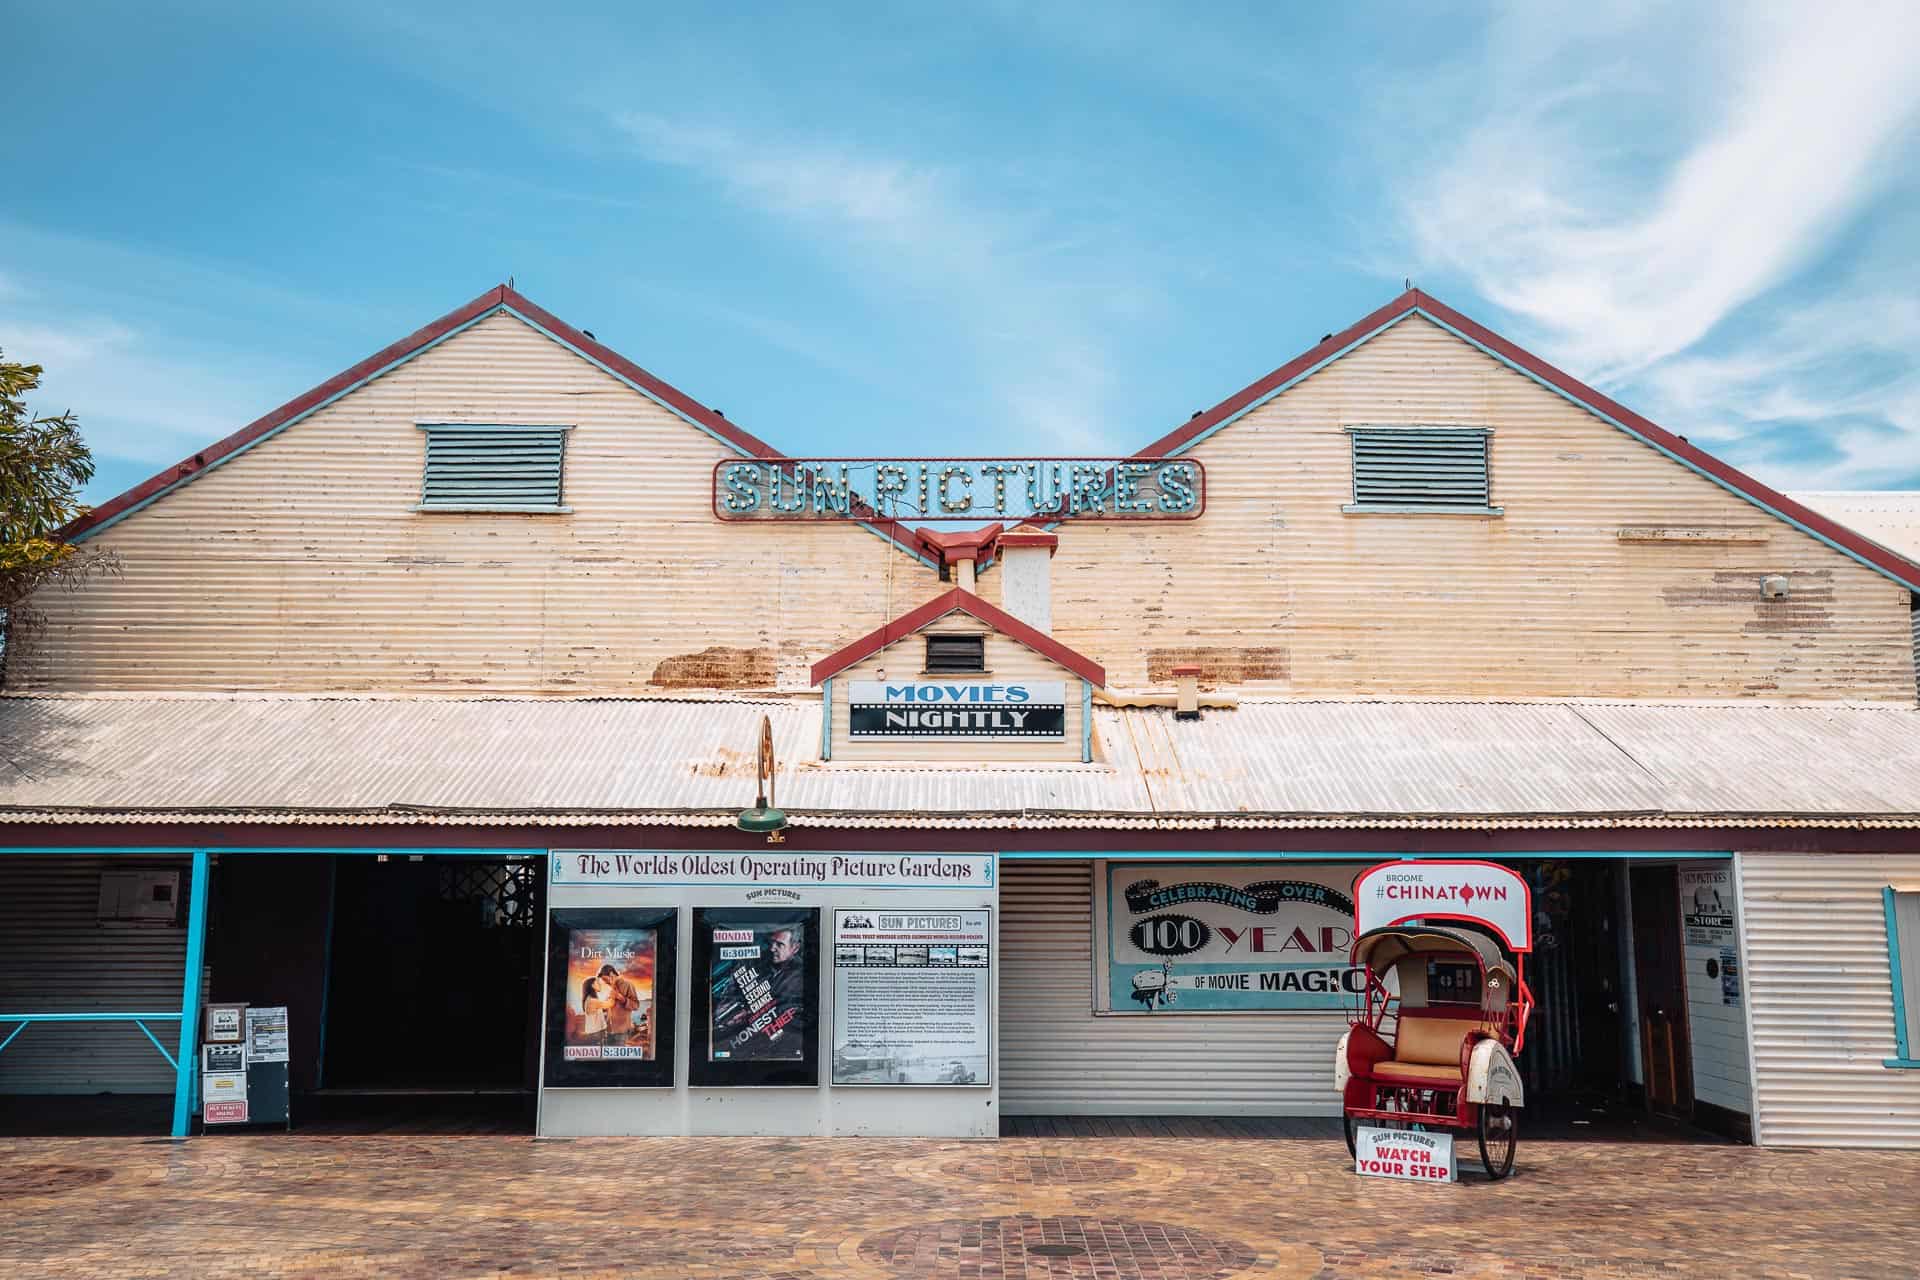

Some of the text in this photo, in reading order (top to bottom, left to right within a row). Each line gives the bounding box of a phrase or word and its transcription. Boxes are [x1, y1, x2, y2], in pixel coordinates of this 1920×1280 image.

[726, 463, 1196, 514] SUN PICTURES
[886, 686, 1030, 703] MOVIES
[886, 711, 1030, 728] NIGHTLY
[577, 855, 972, 881] The Worlds Oldest Operating Picture Gardens
[1386, 874, 1424, 882] BROOME
[746, 890, 762, 900] SUN
[763, 888, 801, 901] PICTURES
[1150, 885, 1326, 910] CELEBRATING OVER
[880, 917, 902, 929] SUN
[907, 917, 960, 929] PICTURES
[714, 931, 753, 942] MONDAY
[1138, 920, 1356, 953] 100 YEAR
[581, 947, 636, 960] Dirt Music
[722, 948, 759, 957] 6:30PM
[736, 968, 759, 988] STEAL
[1195, 968, 1377, 993] OF MOVIE MAGIC
[745, 980, 772, 1004] SECOND
[730, 1007, 777, 1048] HONEST
[761, 1007, 797, 1036] THIEF
[565, 1047, 642, 1057] ONDAY 8:30PM
[1372, 1132, 1436, 1148] SUN PICTURES
[1376, 1147, 1431, 1163] WATCH
[1360, 1160, 1448, 1179] YOUR STEP
